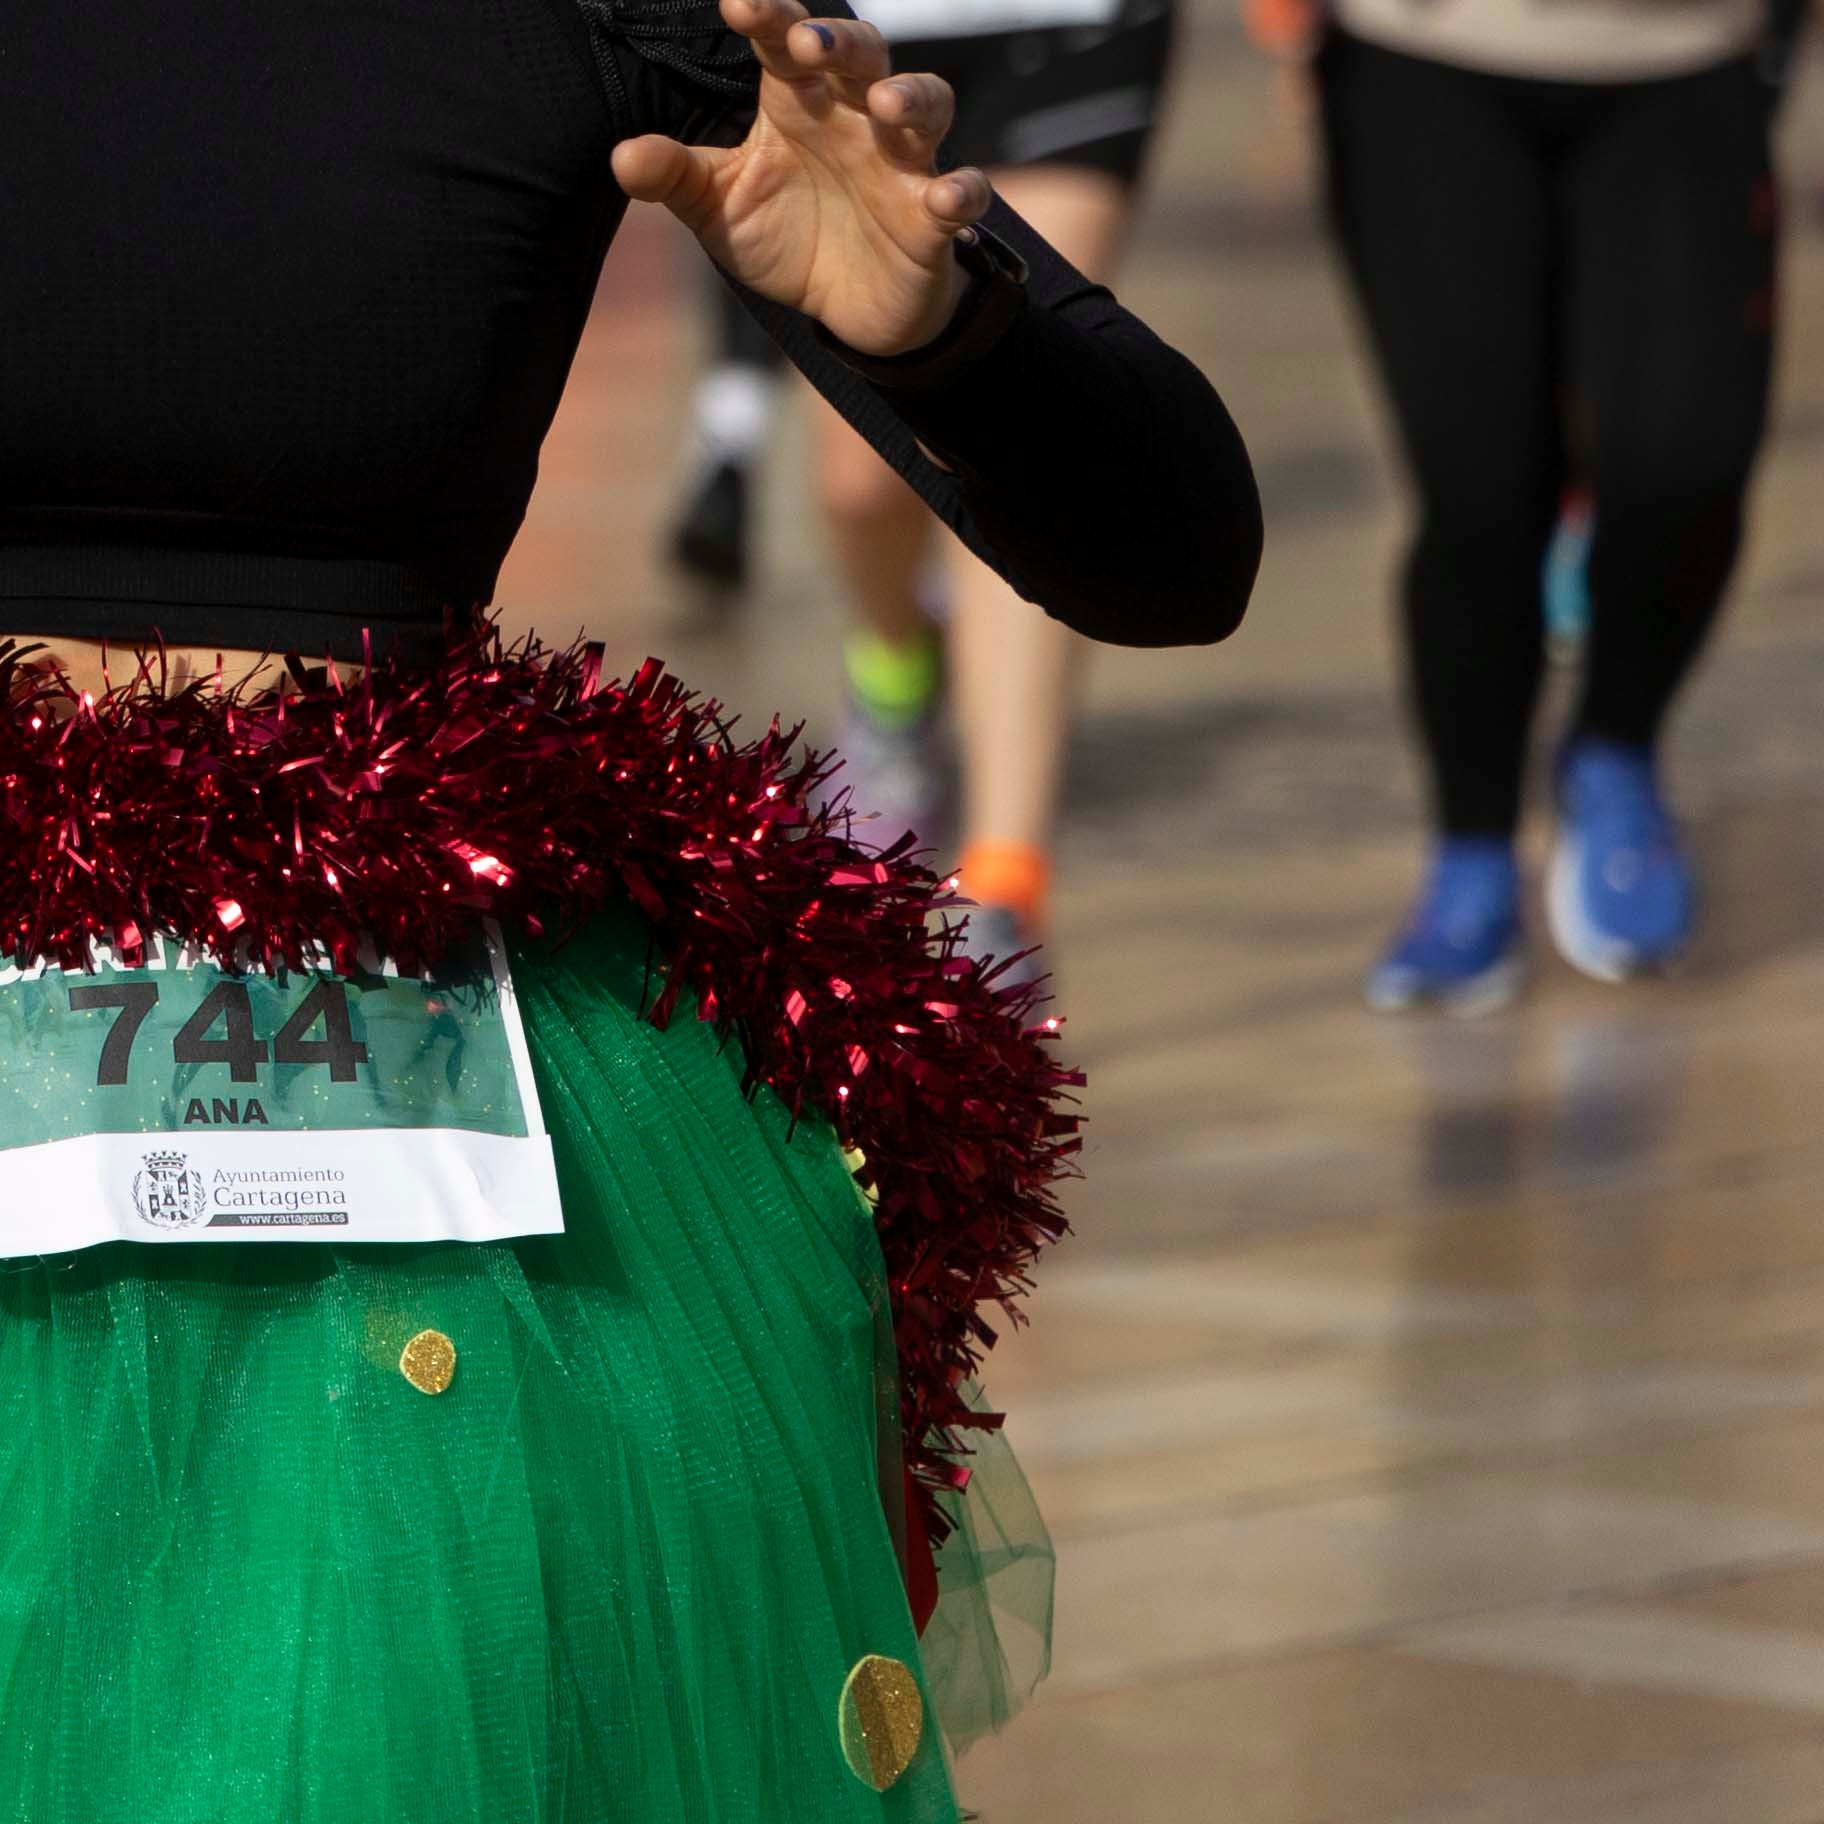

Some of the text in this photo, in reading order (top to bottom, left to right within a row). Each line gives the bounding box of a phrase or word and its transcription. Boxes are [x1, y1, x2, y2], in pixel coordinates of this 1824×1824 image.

[69, 980, 368, 1085] 744
[184, 1098, 268, 1124] ANA
[213, 1168, 344, 1186] Ayuntamiento
[213, 1187, 346, 1210] Cartagena
[239, 1213, 345, 1226] www.cartagena.es
